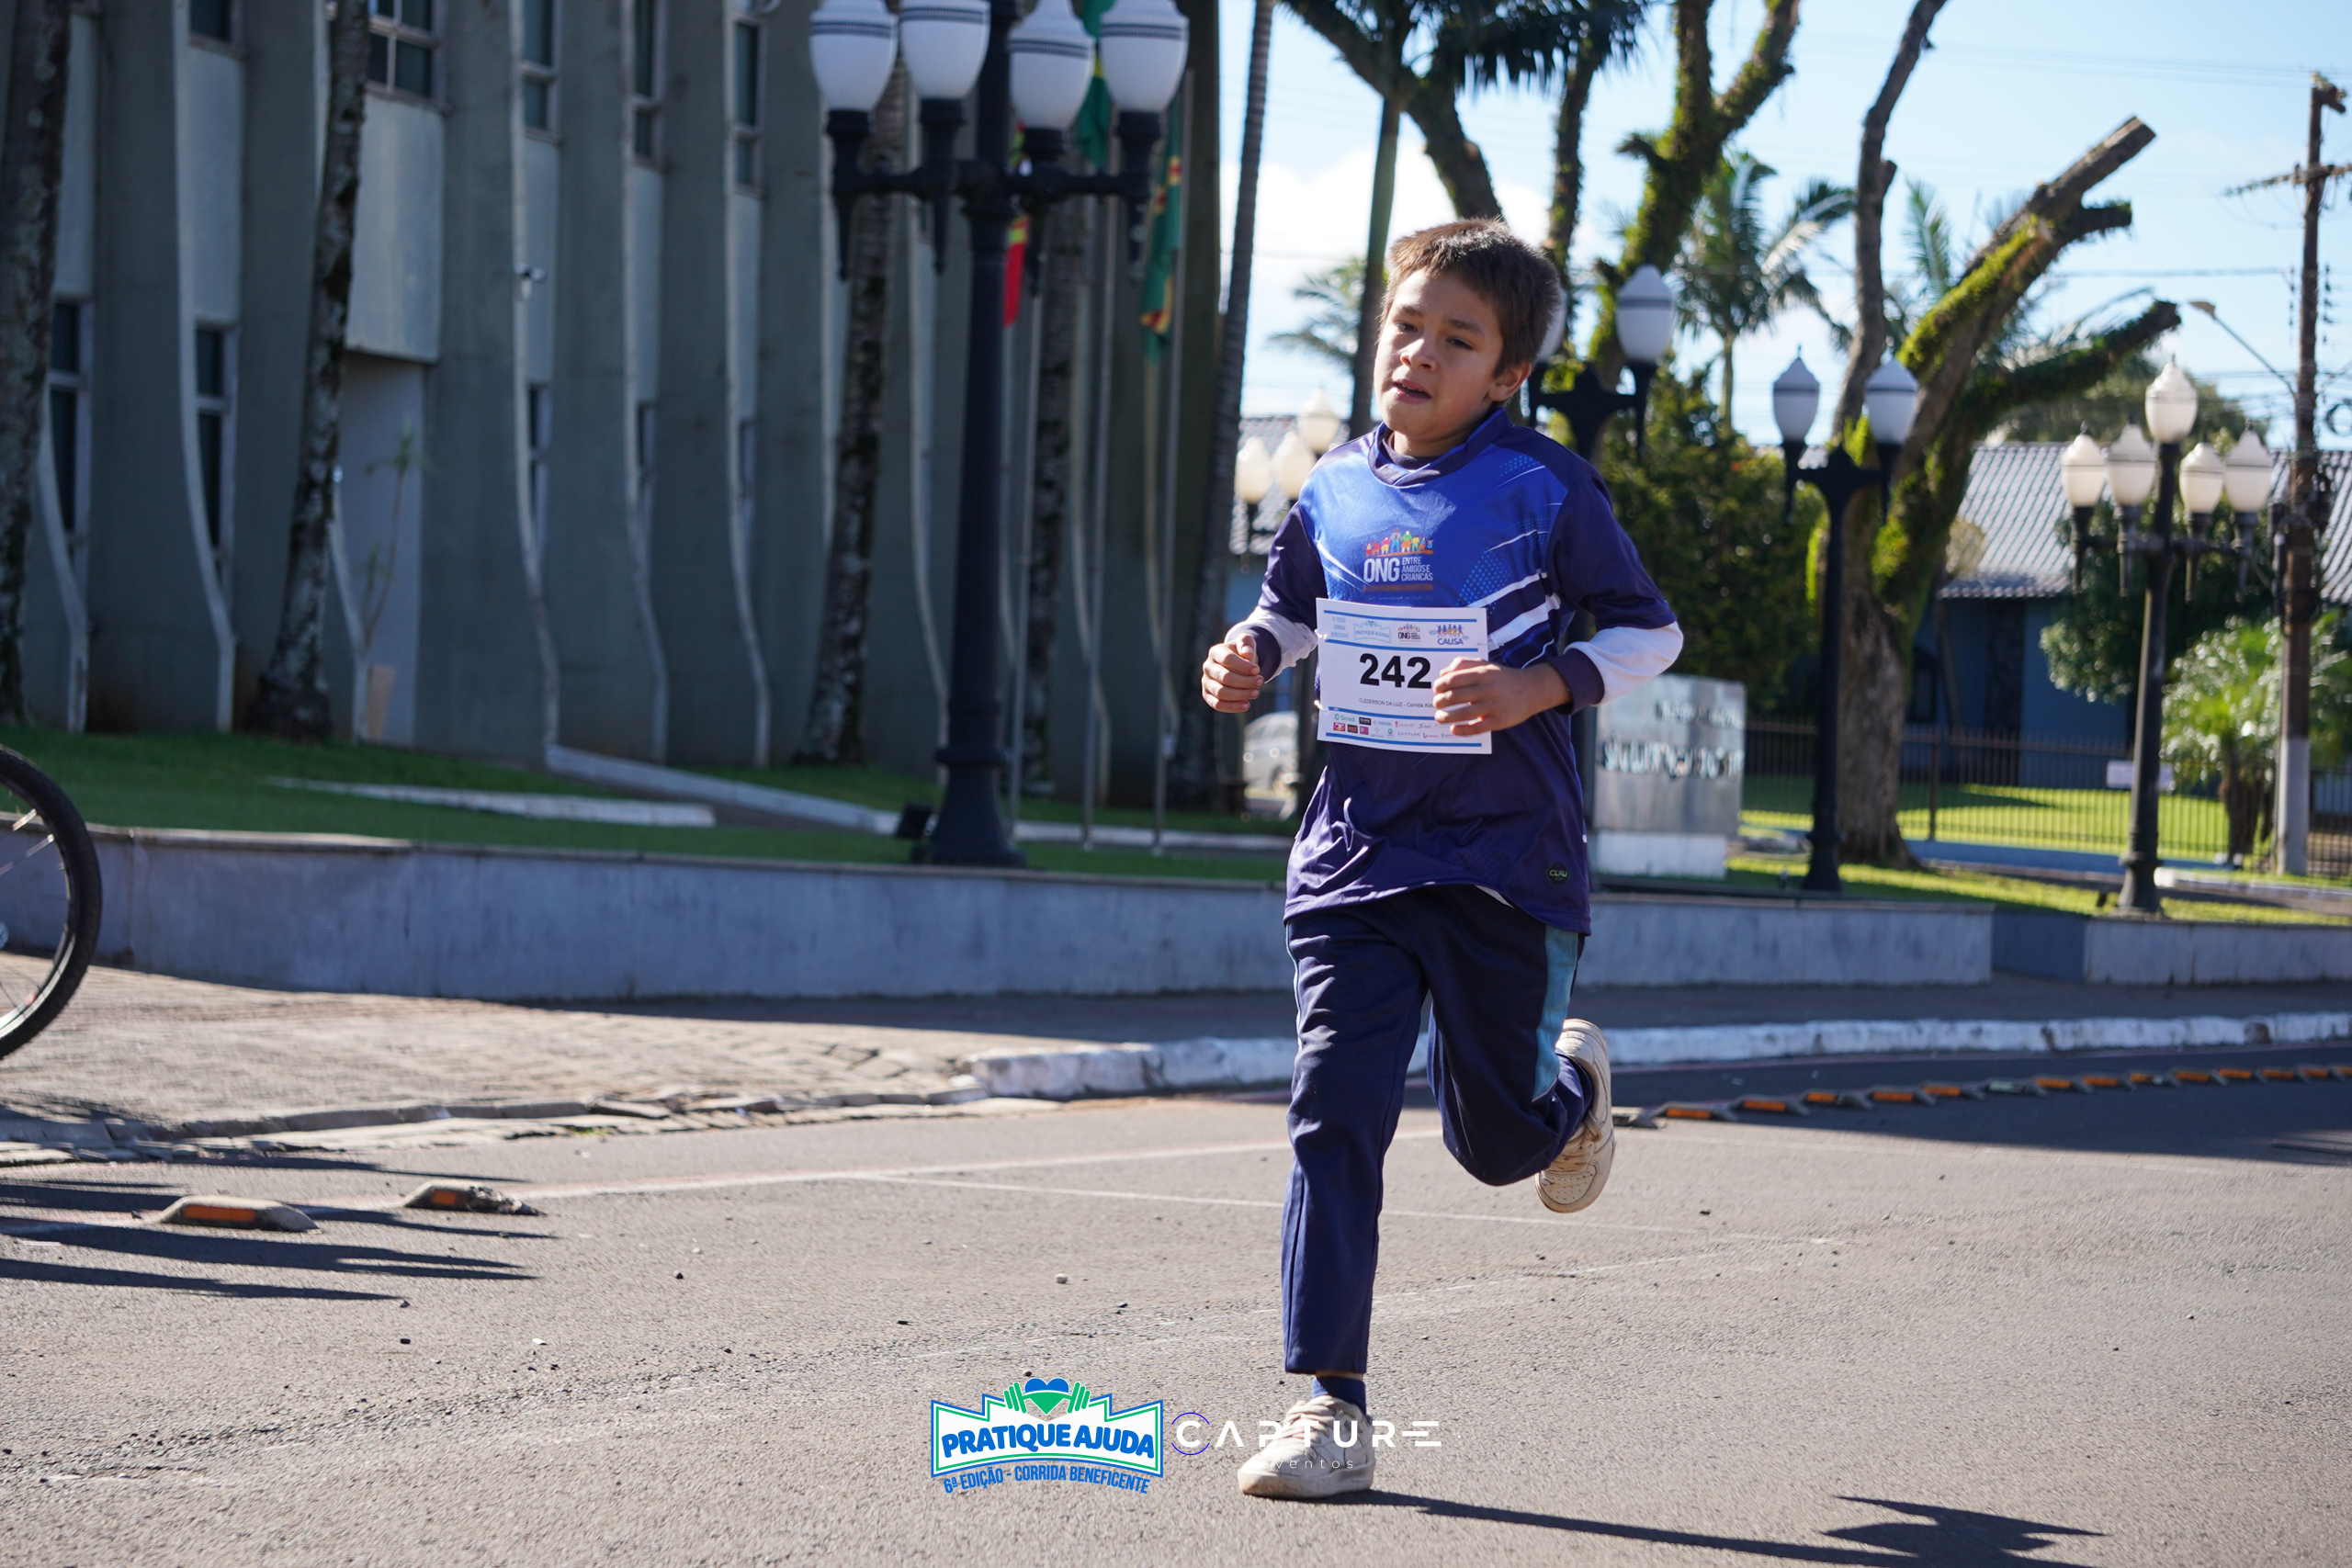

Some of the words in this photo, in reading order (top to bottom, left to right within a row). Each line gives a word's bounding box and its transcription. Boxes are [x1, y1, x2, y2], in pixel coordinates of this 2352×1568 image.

[1402, 557, 1421, 565] ENTRE
[1363, 558, 1400, 582] ONG
[1402, 565, 1425, 573] AMIGOS
[1397, 631, 1411, 639] ONG
[1437, 637, 1464, 646] CAUSA
[1360, 653, 1431, 689] 242
